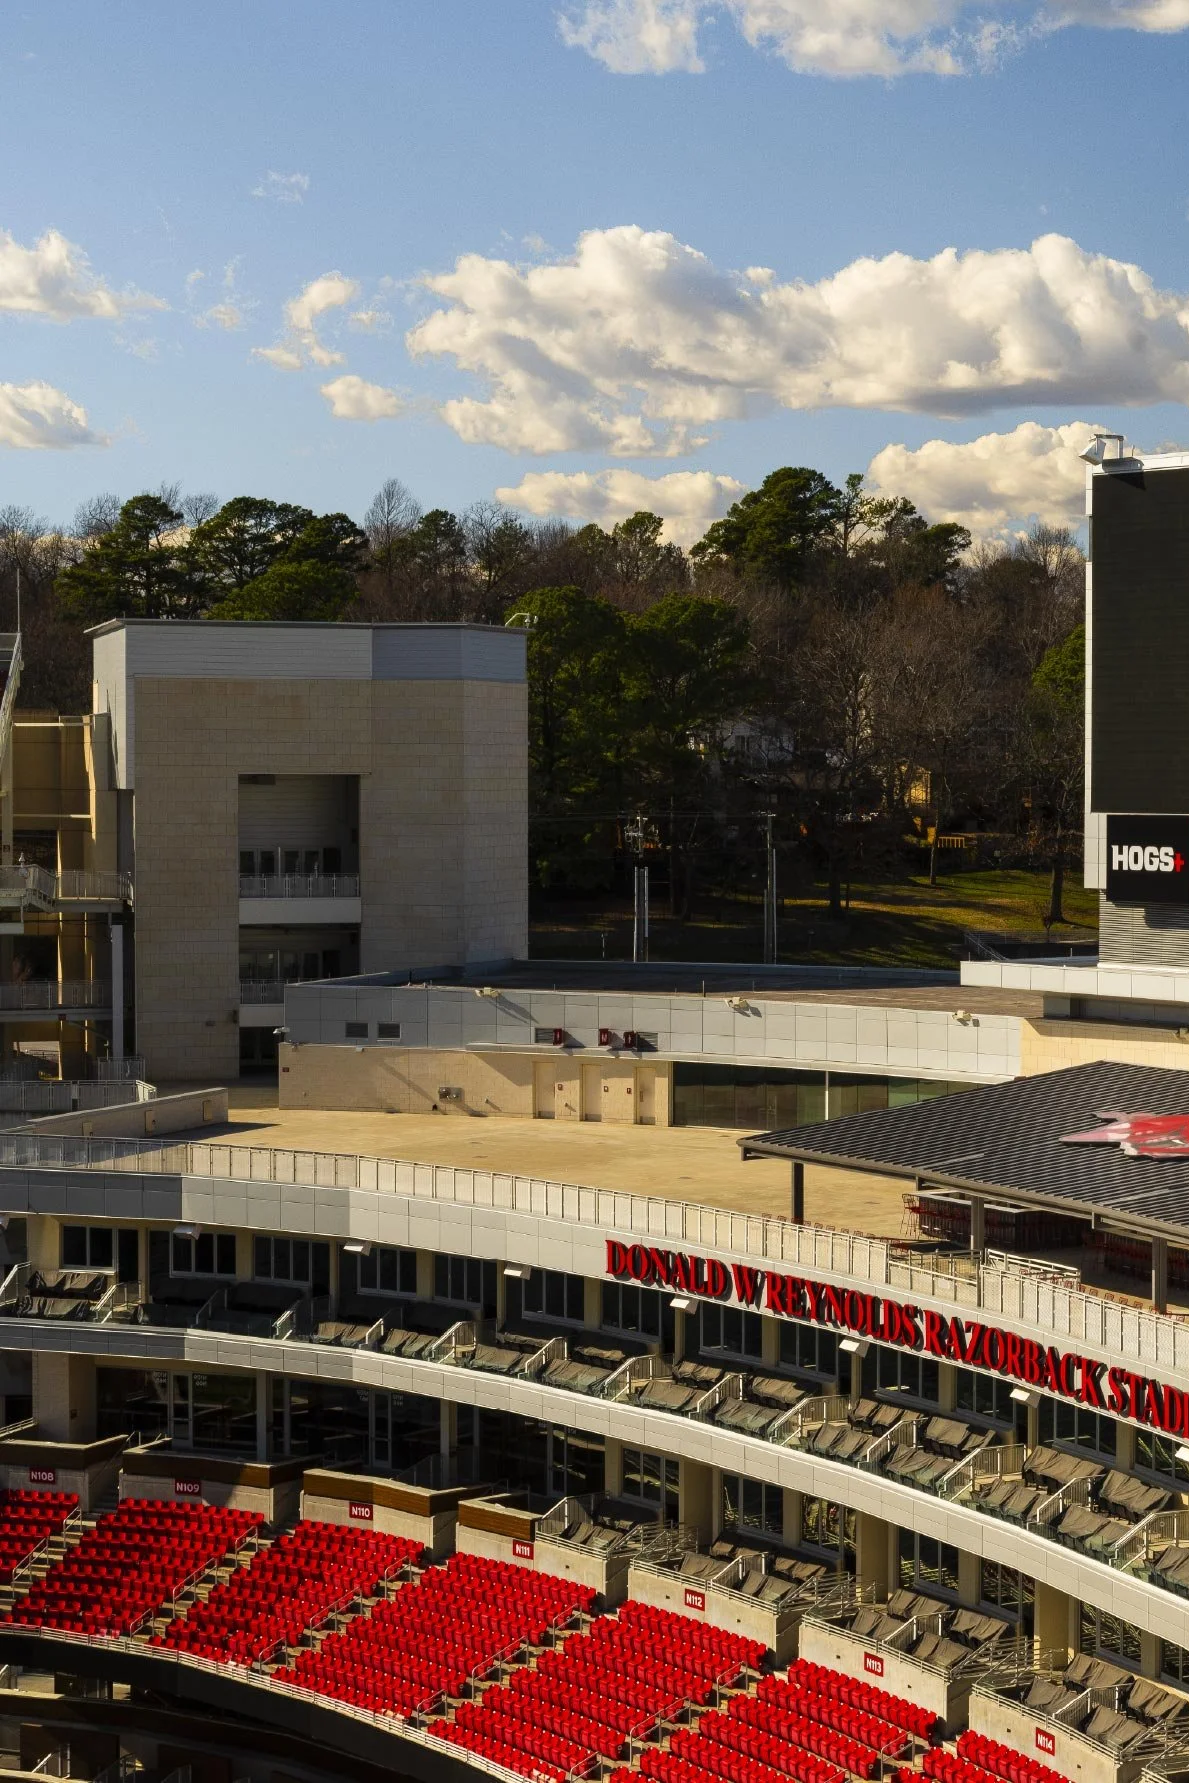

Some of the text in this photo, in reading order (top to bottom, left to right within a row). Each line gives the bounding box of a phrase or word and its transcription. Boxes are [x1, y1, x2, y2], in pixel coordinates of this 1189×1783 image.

[605, 1239, 728, 1297] DONALD
[731, 1263, 759, 1305] W
[764, 1270, 919, 1347] REYNOLDS
[923, 1309, 1102, 1408] RAZORBACK
[30, 1471, 54, 1482] N108
[175, 1482, 200, 1493] N109
[351, 1505, 371, 1518] N110
[515, 1543, 531, 1556] N111
[685, 1593, 703, 1608] N112
[866, 1657, 882, 1673] N113
[1036, 1733, 1053, 1750] N114
